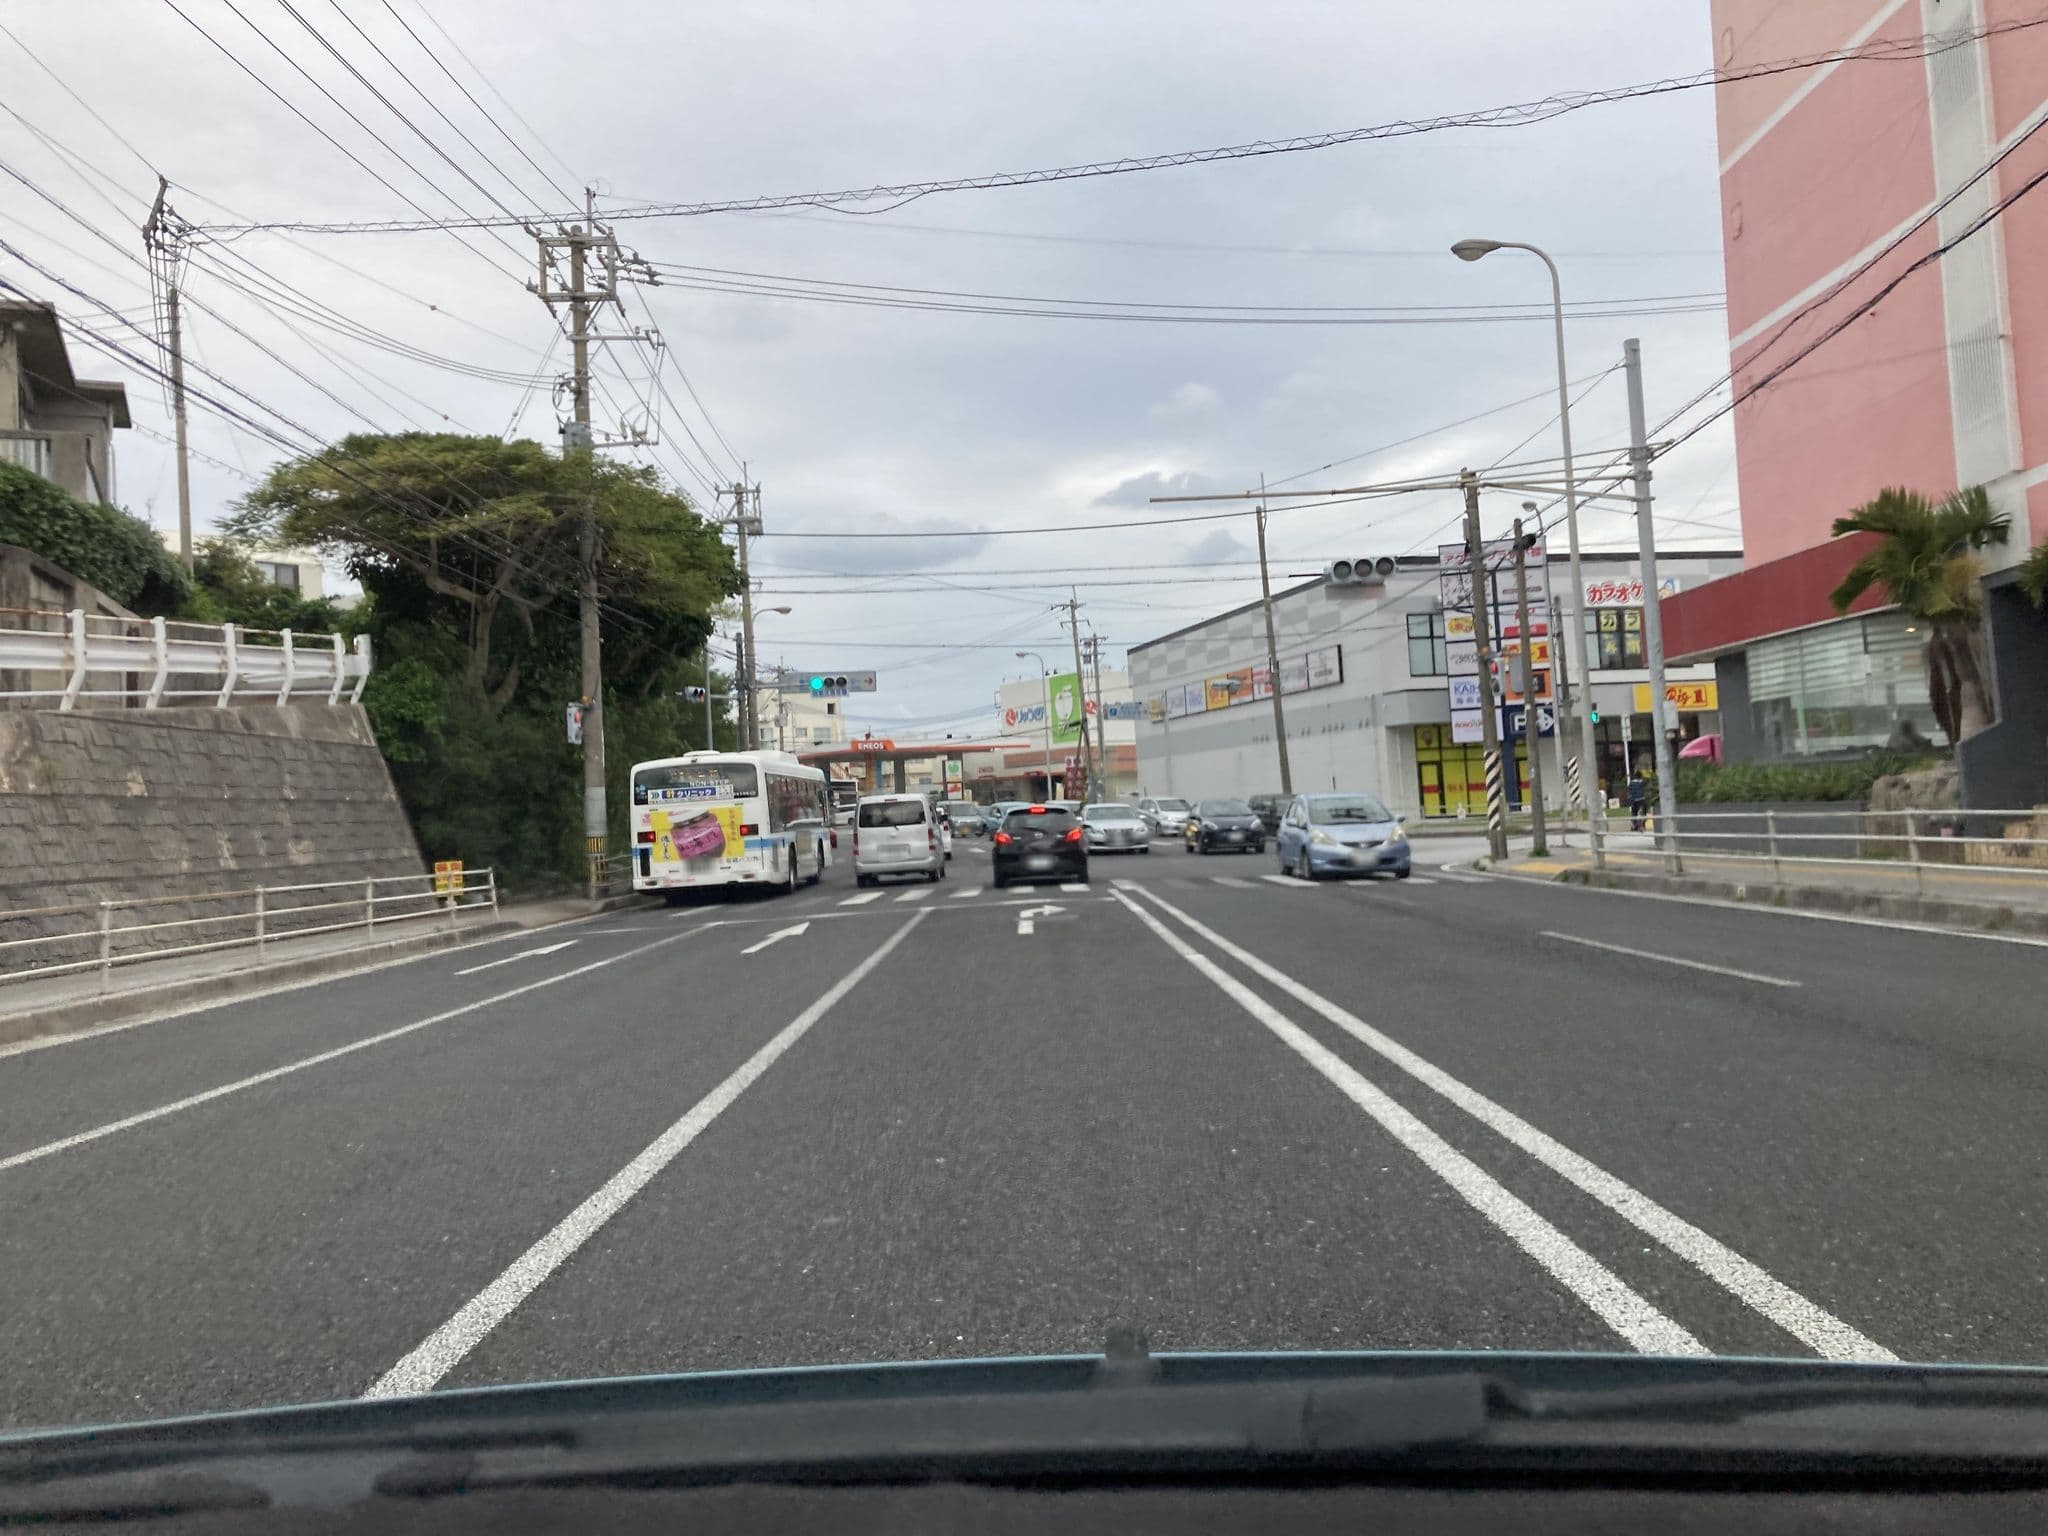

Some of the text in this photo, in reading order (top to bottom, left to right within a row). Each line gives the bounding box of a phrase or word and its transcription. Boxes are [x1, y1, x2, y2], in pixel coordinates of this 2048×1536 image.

[1588, 582, 1643, 605] カラオケ
[1693, 688, 1706, 704] 1
[858, 743, 885, 751] ENEOS
[677, 788, 712, 798] クリニック
